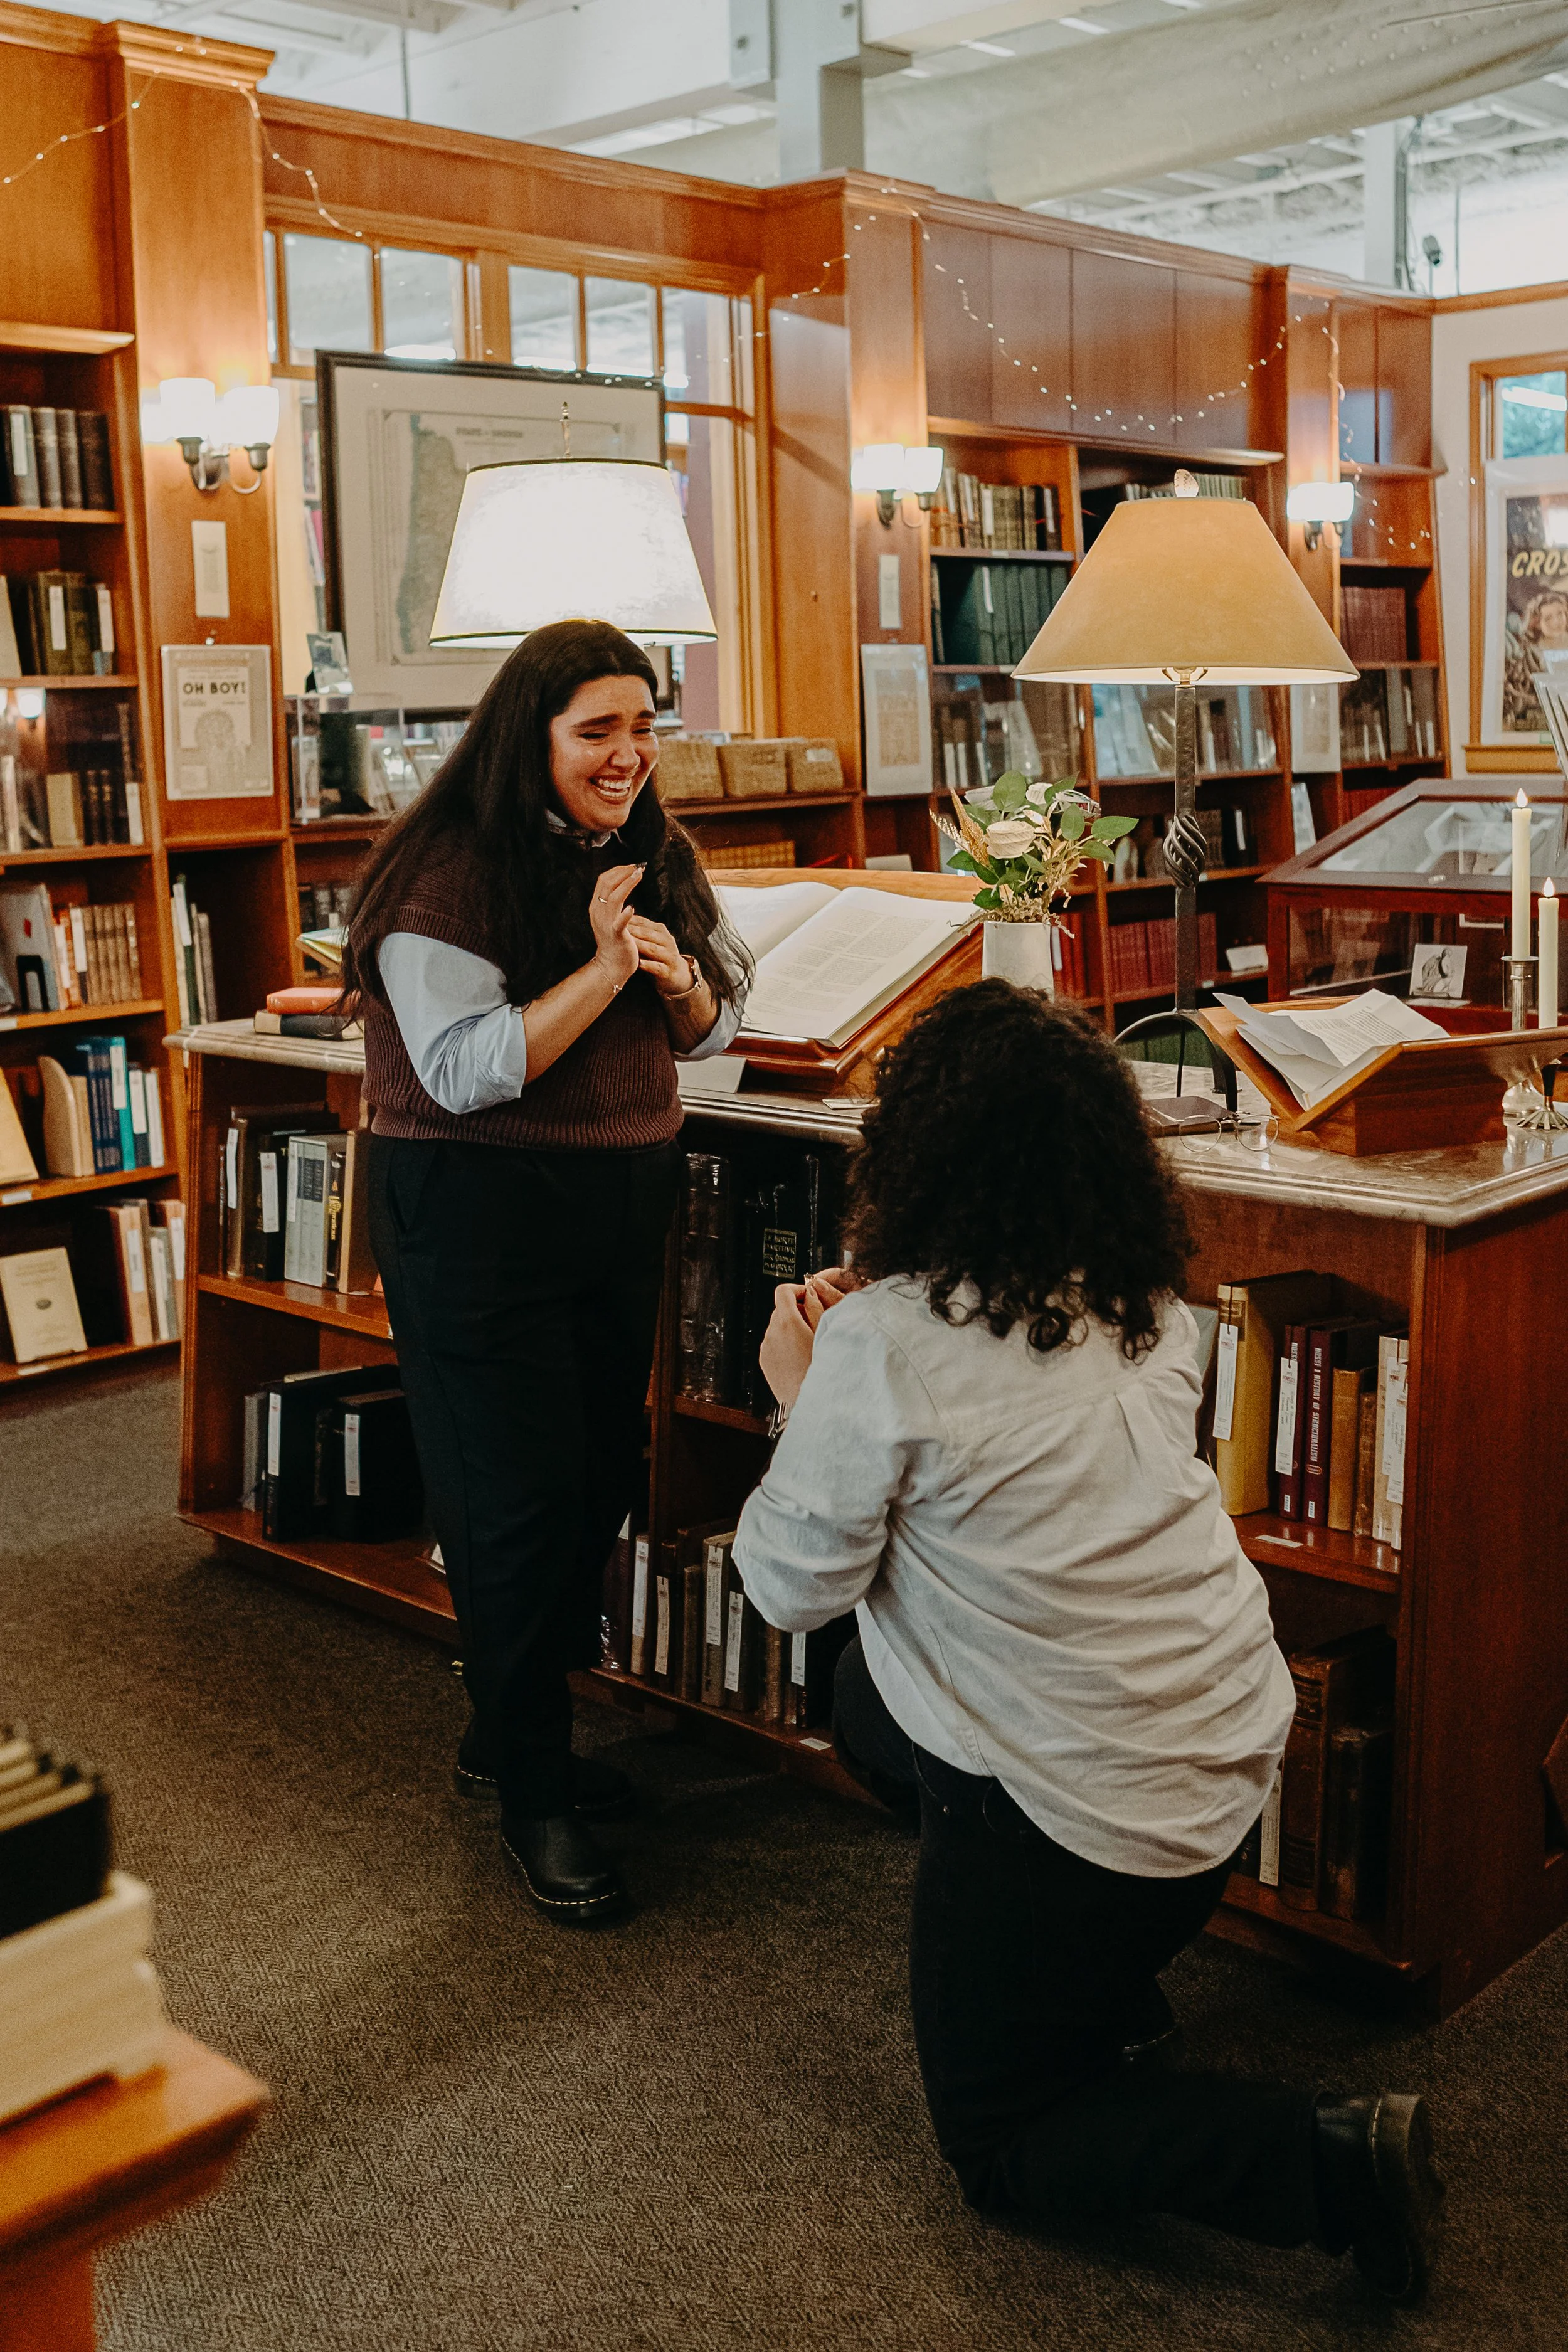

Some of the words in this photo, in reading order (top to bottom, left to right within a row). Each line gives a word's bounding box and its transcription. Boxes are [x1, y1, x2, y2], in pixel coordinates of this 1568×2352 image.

[183, 682, 204, 694] OH
[210, 682, 245, 694] BOY!
[1313, 1374, 1321, 1401] HISTORY
[1313, 1402, 1320, 1411] OF
[1310, 1412, 1319, 1462] STRUCTURALISM
